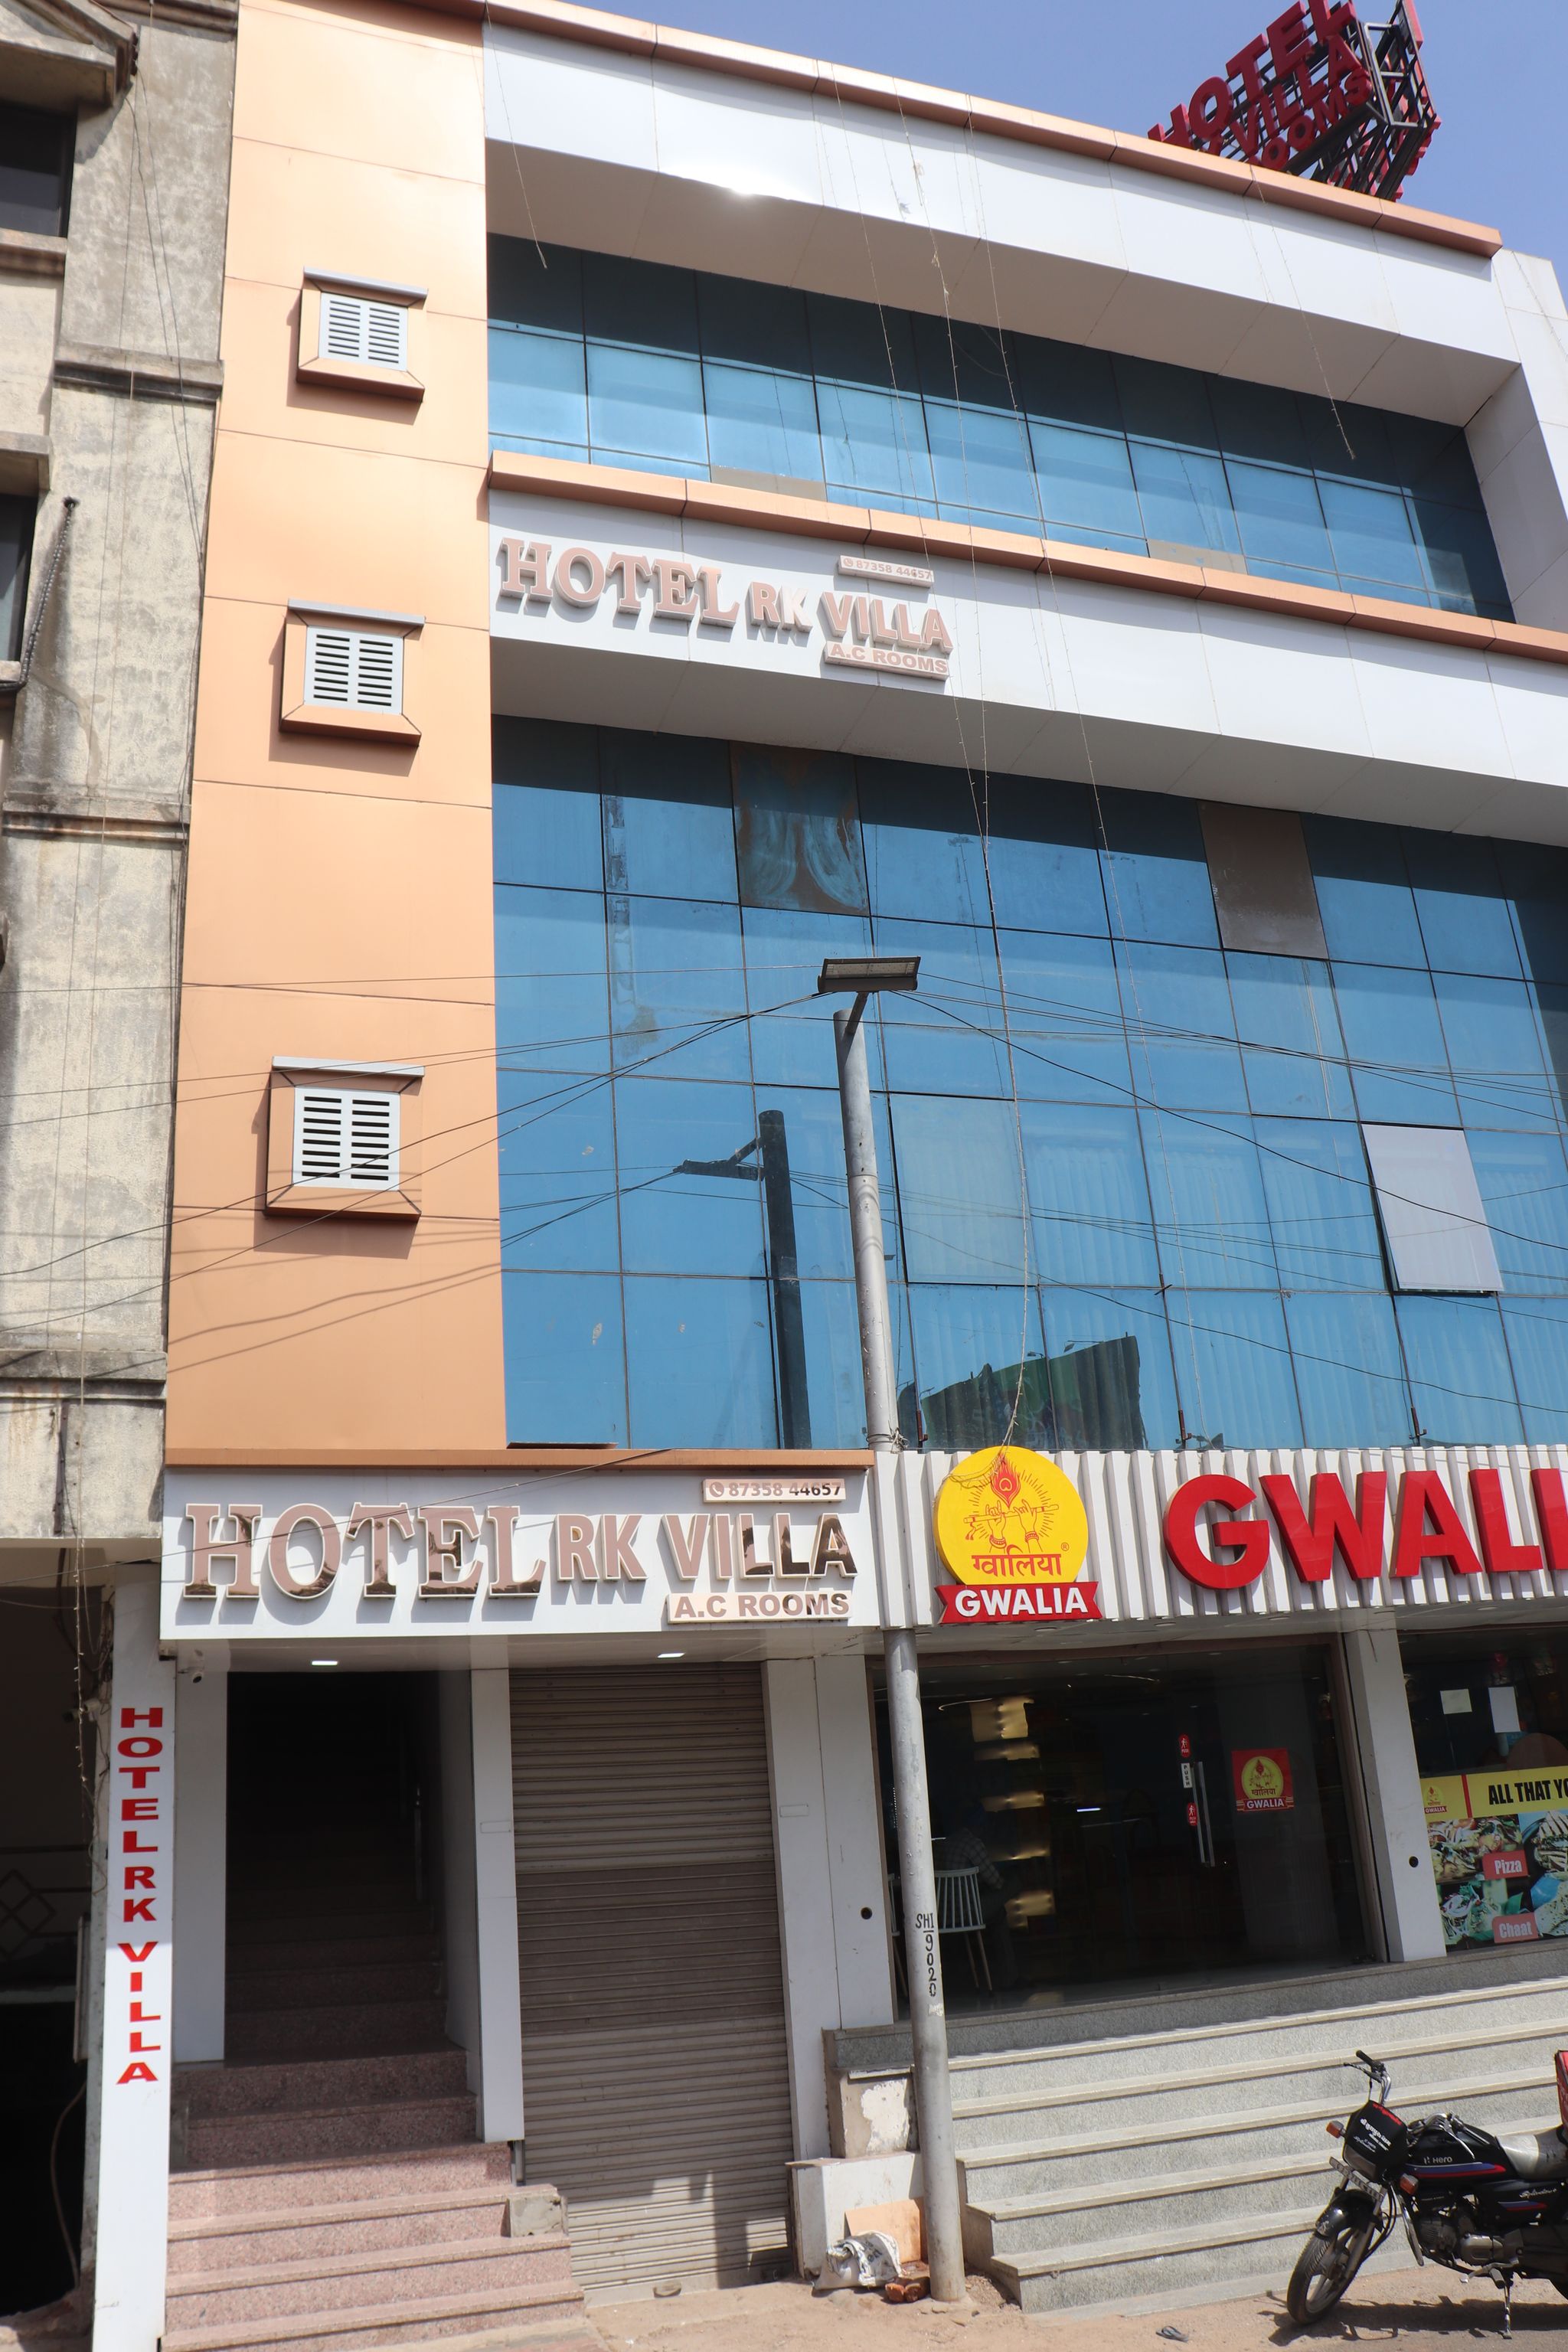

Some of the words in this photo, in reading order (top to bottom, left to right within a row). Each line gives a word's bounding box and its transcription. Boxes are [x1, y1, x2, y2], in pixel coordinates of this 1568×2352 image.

[1148, 0, 1357, 151] HOTEL
[1230, 35, 1363, 158] VILLA
[1248, 67, 1373, 171] OOMS
[856, 560, 893, 573] 87358
[897, 567, 932, 580] 44657
[500, 537, 740, 628] HOTEL
[748, 581, 813, 632] RK
[819, 590, 954, 654] VILLA
[830, 644, 866, 660] A.C
[872, 649, 948, 674] ROOMS
[728, 1482, 783, 1497] 87358
[789, 1481, 841, 1496] 44657
[1163, 1468, 1568, 1590] GWALI
[183, 1501, 546, 1600] HOTEL
[554, 1513, 648, 1582] RK
[662, 1513, 858, 1580] VILLA
[971, 1544, 1062, 1577] ग्वालिया
[674, 1595, 727, 1619] A.C
[738, 1592, 850, 1617] ROOMS
[955, 1587, 1089, 1617] GWALIA
[117, 1707, 164, 1854] HOTEL
[1488, 1783, 1514, 1805] ALL
[1514, 1780, 1551, 1802] THAT
[1246, 1798, 1285, 1809] GWALIA
[1494, 1859, 1523, 1875] Pizza
[915, 1913, 935, 1929] SHI
[1498, 1922, 1534, 1939] Chaat
[116, 1941, 162, 2085] VILLA
